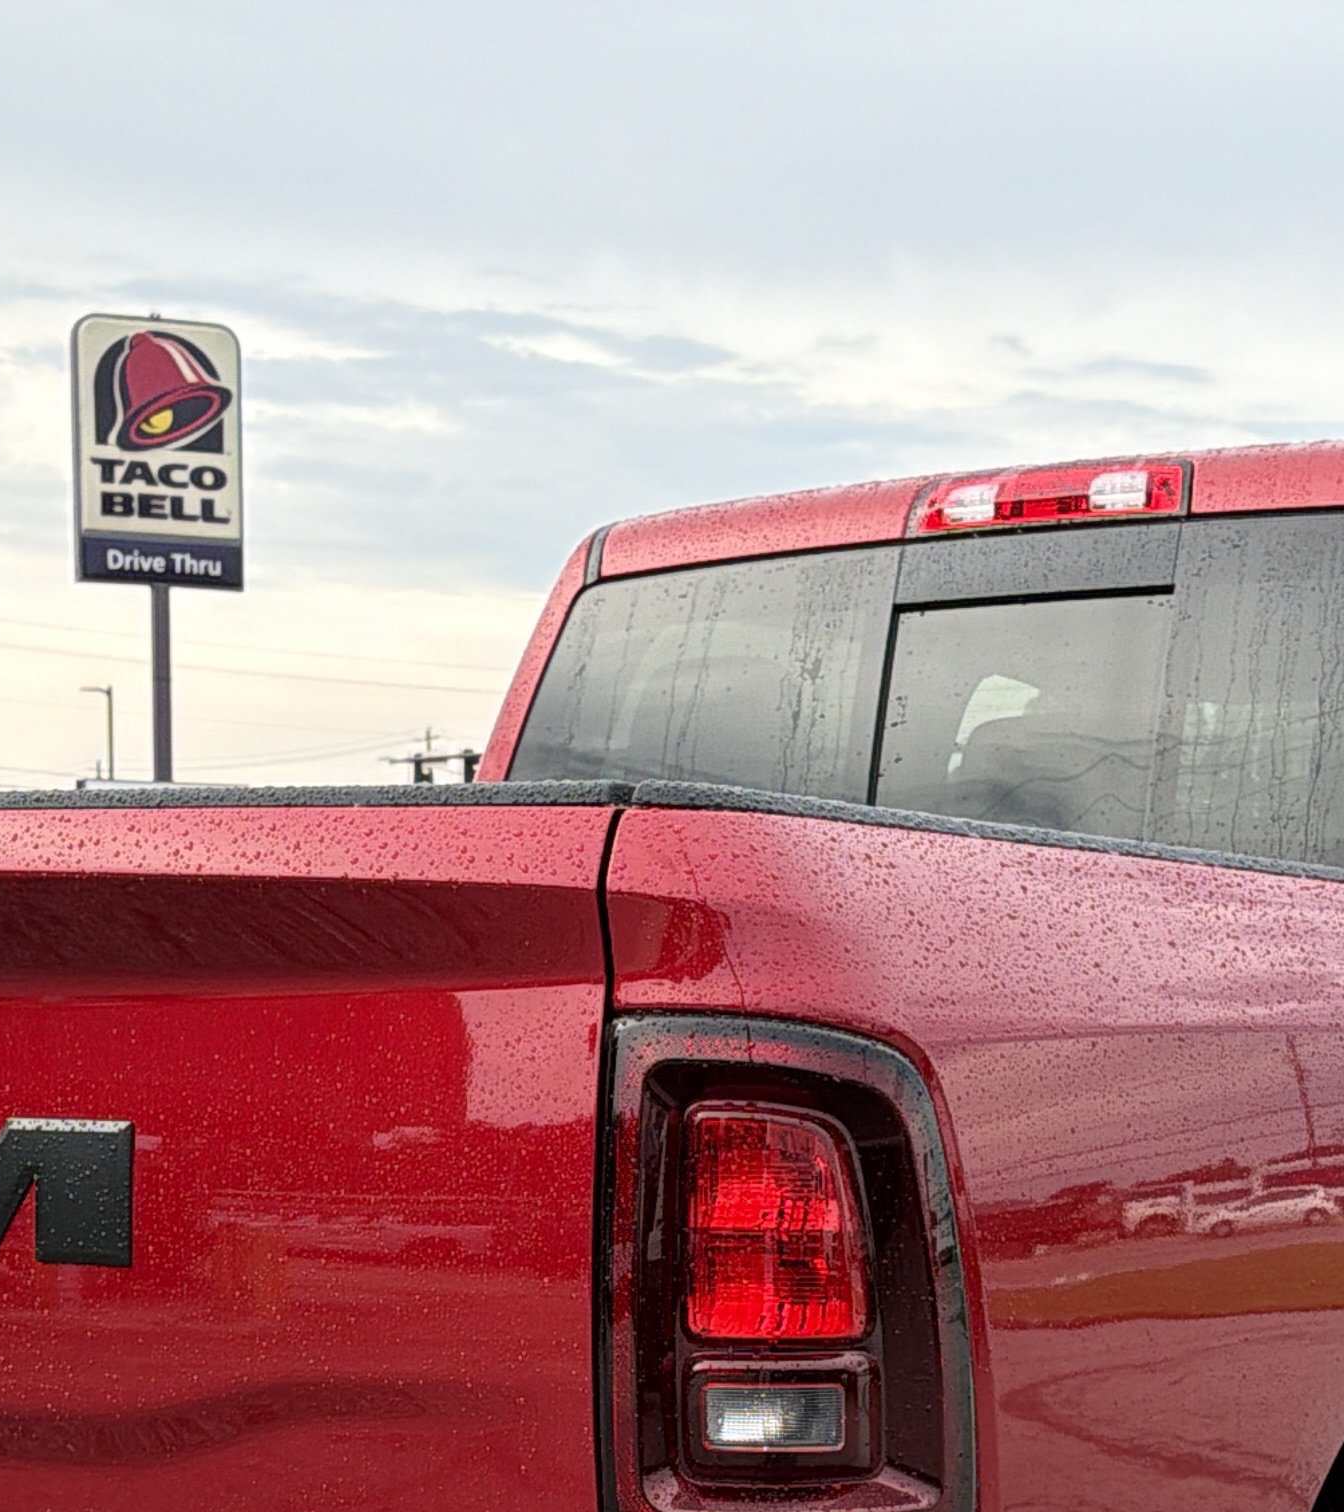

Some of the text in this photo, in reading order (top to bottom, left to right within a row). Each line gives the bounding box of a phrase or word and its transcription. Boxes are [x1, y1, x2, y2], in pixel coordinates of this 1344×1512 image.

[90, 457, 227, 491] TACO
[101, 491, 231, 524] BELL
[106, 549, 222, 577] Drive Thru
